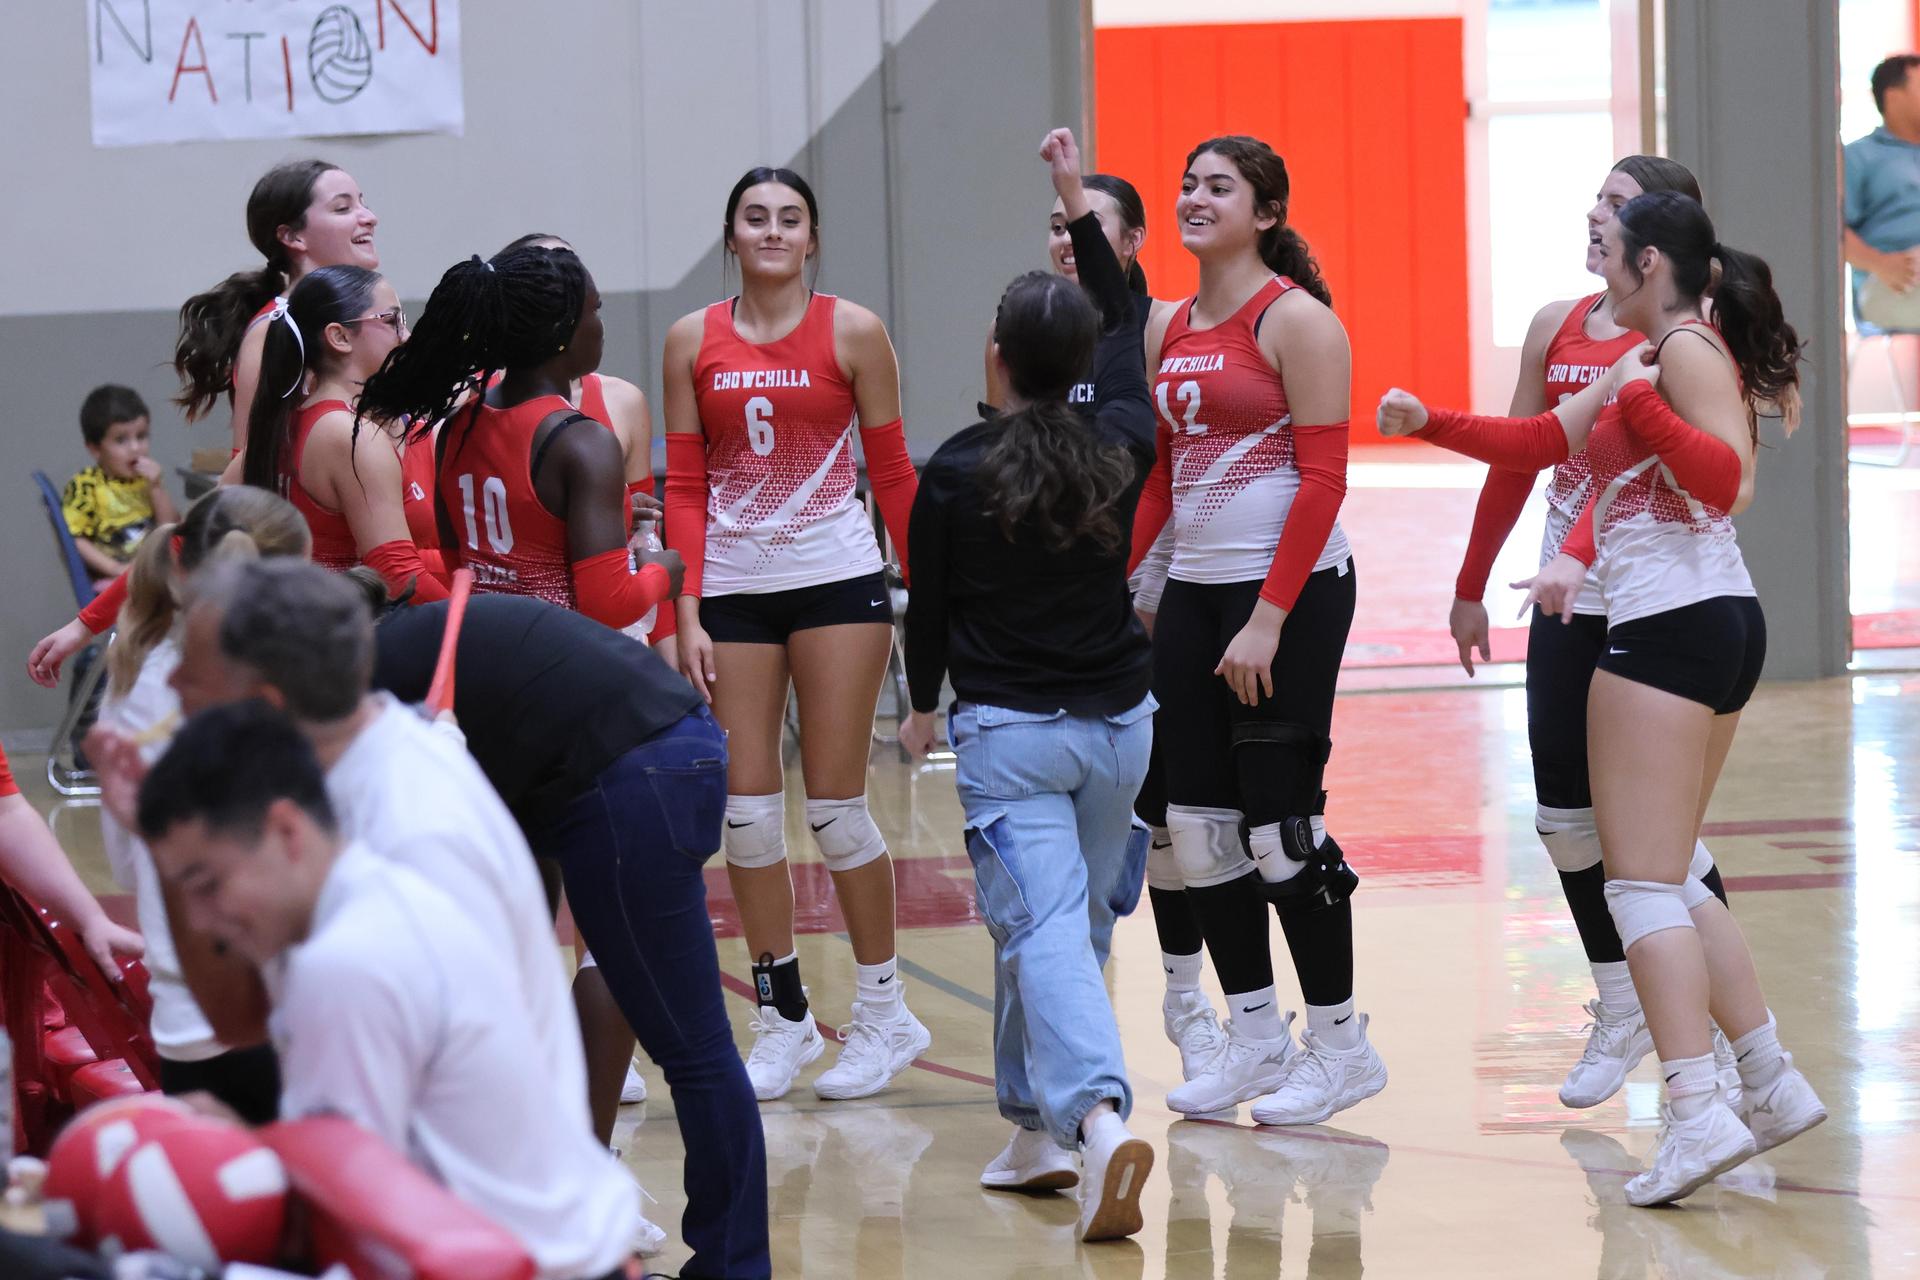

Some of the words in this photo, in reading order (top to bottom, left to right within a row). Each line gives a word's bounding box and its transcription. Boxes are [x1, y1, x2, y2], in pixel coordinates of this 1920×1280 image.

[713, 369, 811, 391] CHOWCHILLA
[1155, 380, 1208, 435] 12
[744, 396, 775, 456] 6
[458, 473, 514, 554] 10
